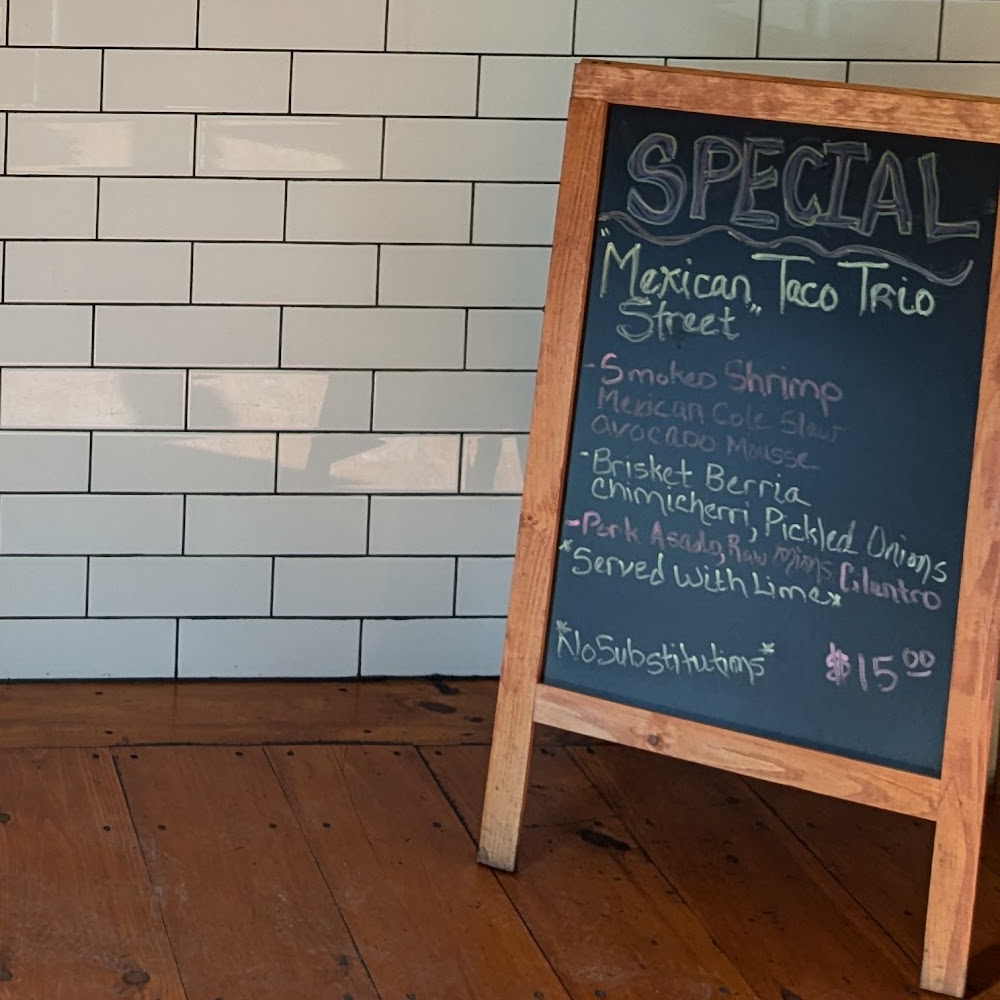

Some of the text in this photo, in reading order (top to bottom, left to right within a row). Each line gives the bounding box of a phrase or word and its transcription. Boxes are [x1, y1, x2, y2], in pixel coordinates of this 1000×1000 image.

[627, 132, 979, 243] SPECIAL
[751, 253, 838, 315] Taco
[724, 359, 843, 418] Shrimp
[765, 508, 858, 555] Pickled
